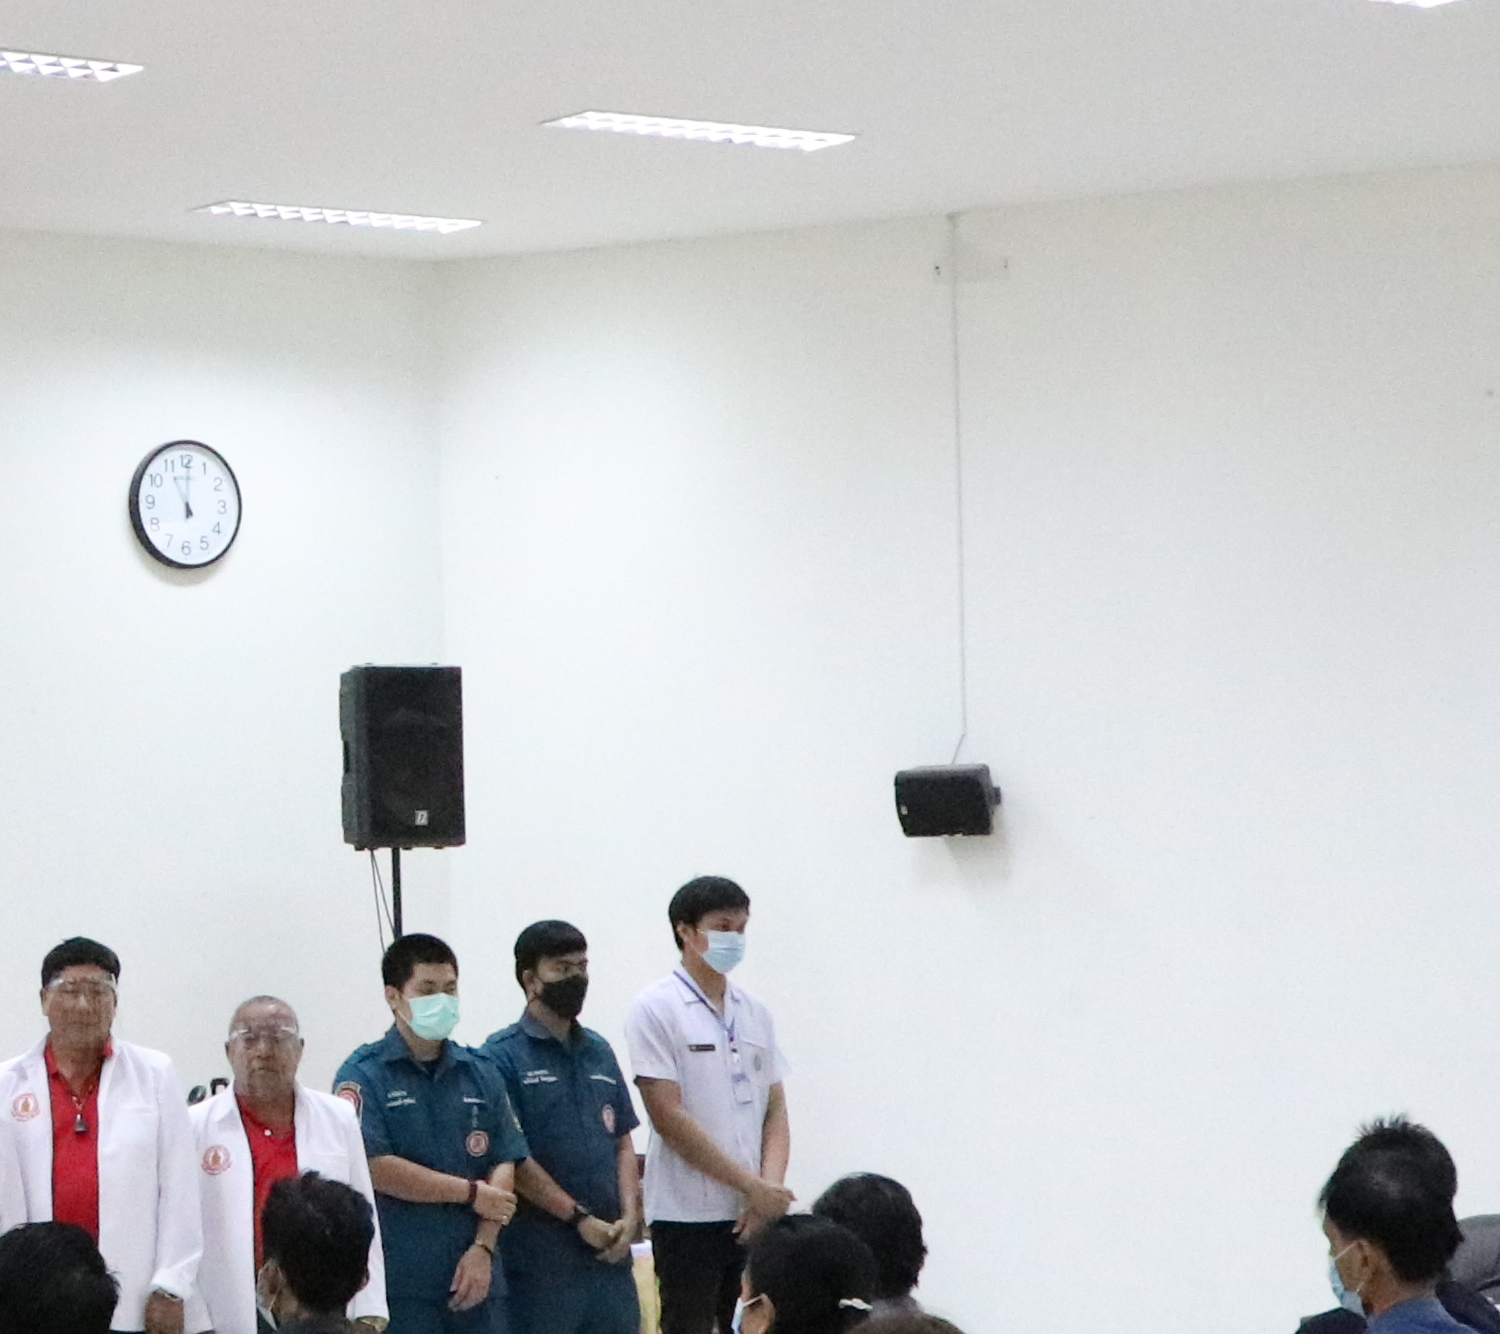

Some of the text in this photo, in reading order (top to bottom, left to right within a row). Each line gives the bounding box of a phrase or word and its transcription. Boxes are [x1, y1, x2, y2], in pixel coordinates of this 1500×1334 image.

[163, 458, 175, 473] 11
[179, 454, 194, 469] 12
[201, 461, 208, 475] 1
[149, 473, 163, 488] 10
[213, 477, 224, 492] 2
[144, 494, 156, 510] 9
[217, 500, 228, 515] 3
[149, 517, 160, 532] 8
[212, 521, 222, 536] 4
[164, 534, 174, 548] 7
[181, 540, 192, 556] 6
[199, 536, 210, 551] 5
